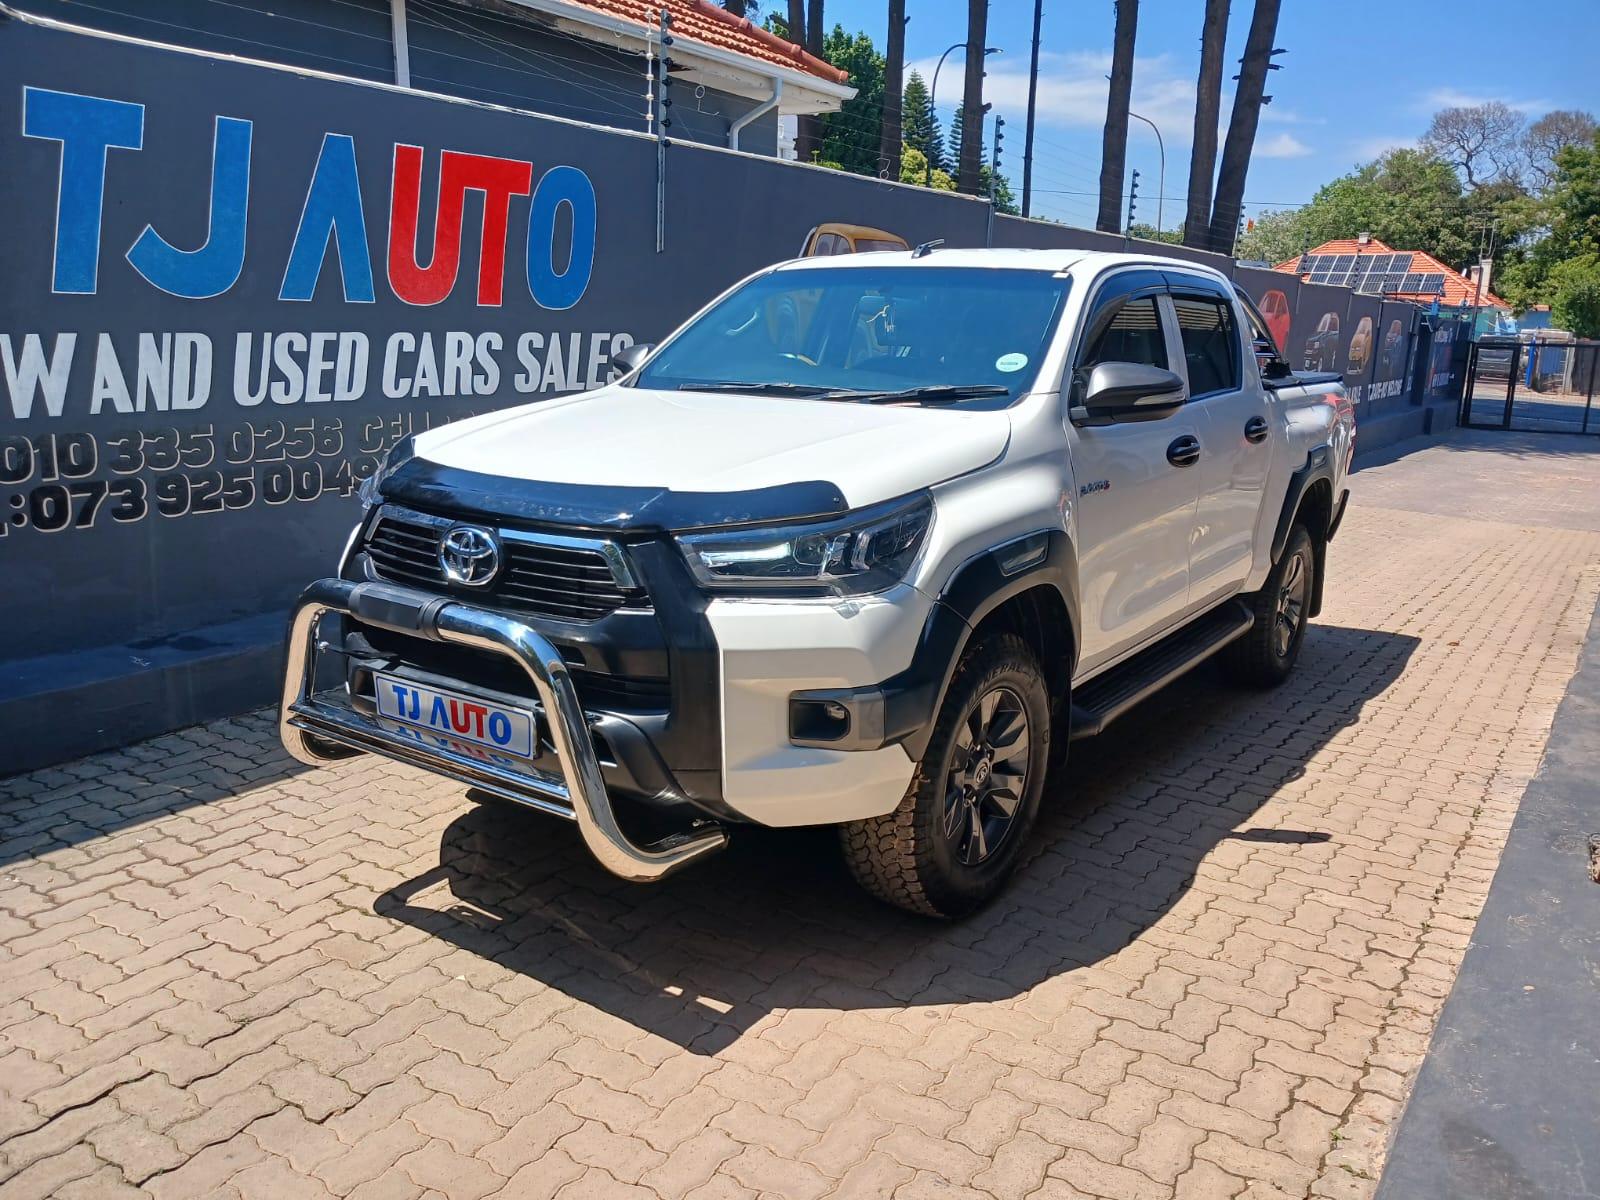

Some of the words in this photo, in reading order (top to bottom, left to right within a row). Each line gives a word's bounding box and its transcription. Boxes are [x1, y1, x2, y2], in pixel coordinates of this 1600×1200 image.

[22, 85, 254, 299] TJ
[278, 131, 598, 311] AUTO
[0, 332, 78, 419] W
[90, 332, 214, 415] AND
[232, 331, 370, 407] USED
[381, 331, 504, 399] CARS
[0, 432, 98, 485] 010
[106, 423, 215, 475] 335
[225, 417, 344, 465] 0256
[155, 466, 256, 518] 925
[392, 684, 421, 720] TJ
[430, 697, 513, 746] AUTO
